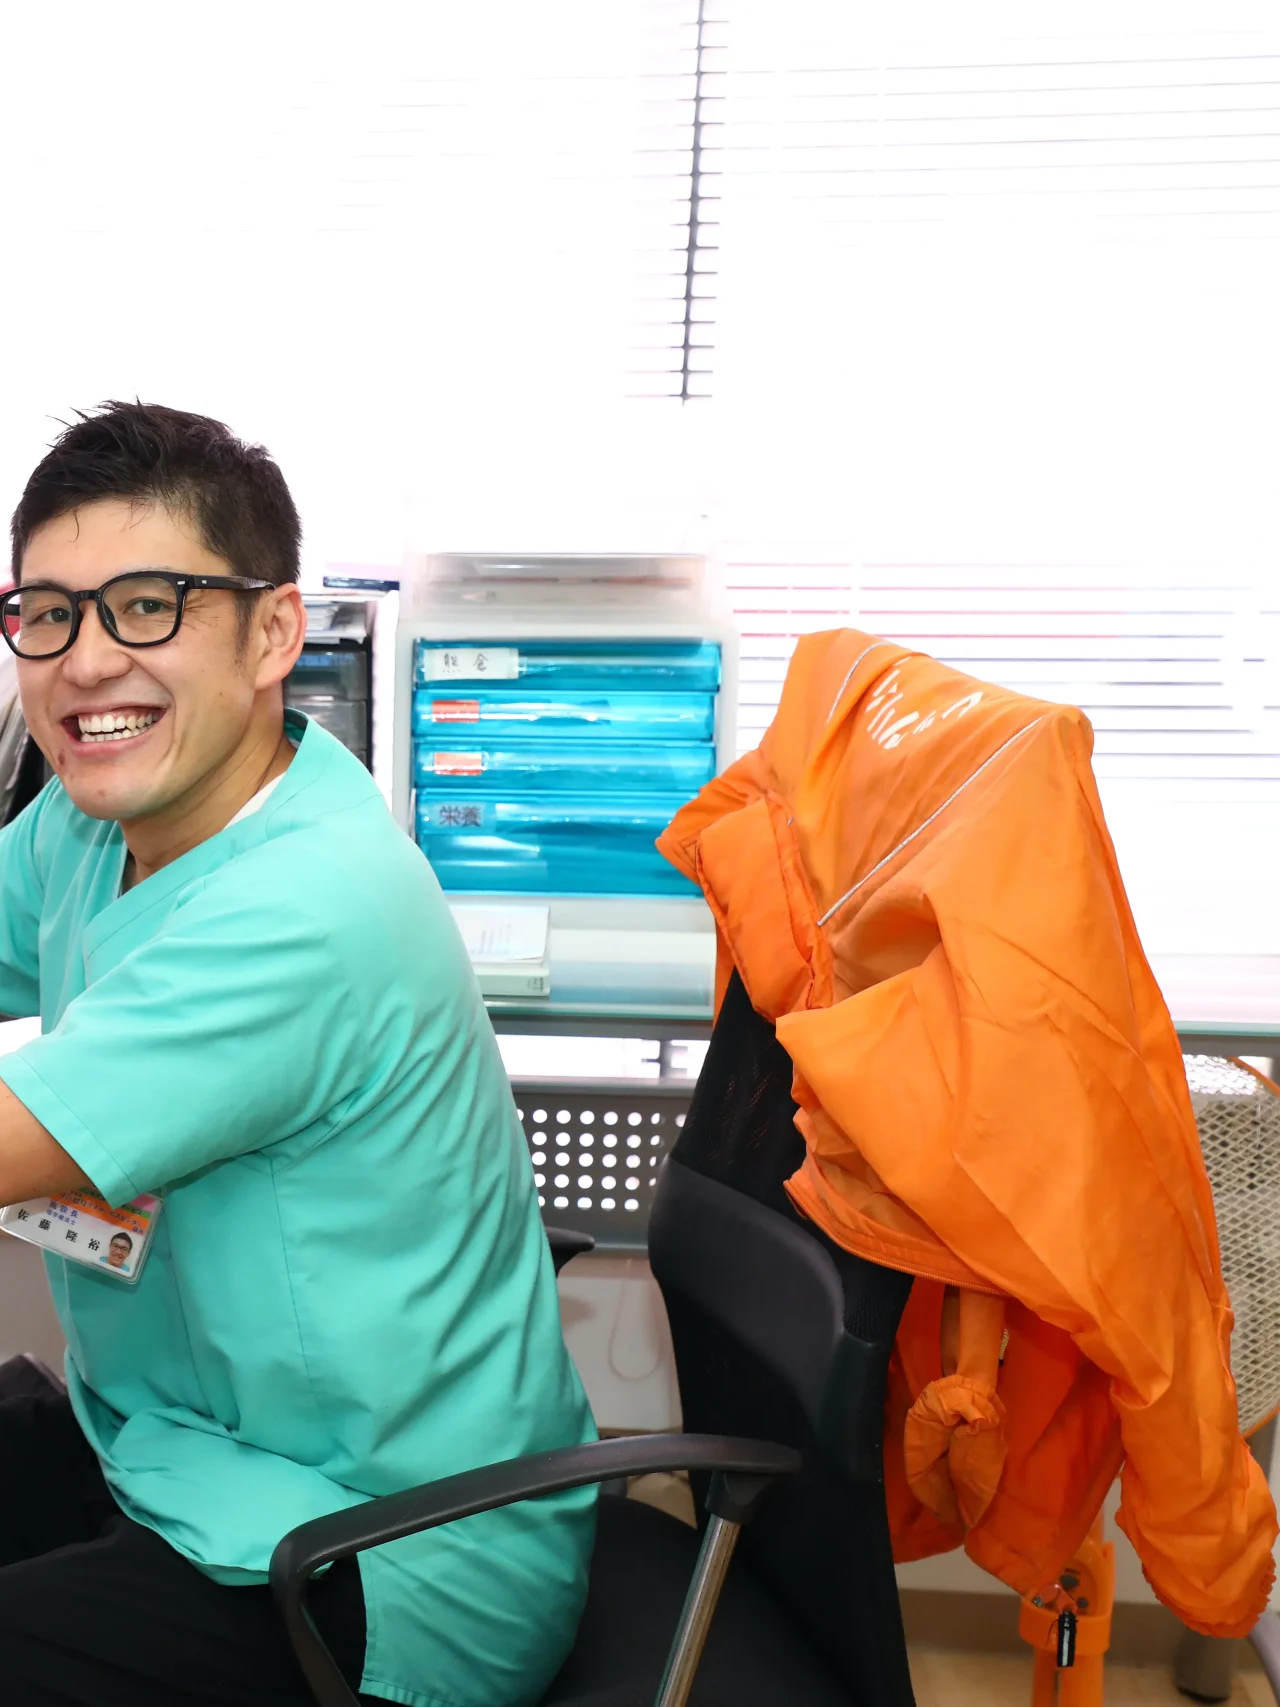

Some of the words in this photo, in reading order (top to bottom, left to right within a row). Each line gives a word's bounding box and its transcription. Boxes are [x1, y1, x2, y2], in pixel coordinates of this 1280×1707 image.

[439, 805, 481, 827] 栄養
[47, 1209, 77, 1226] 理学療法士
[49, 1200, 78, 1218] 施設長
